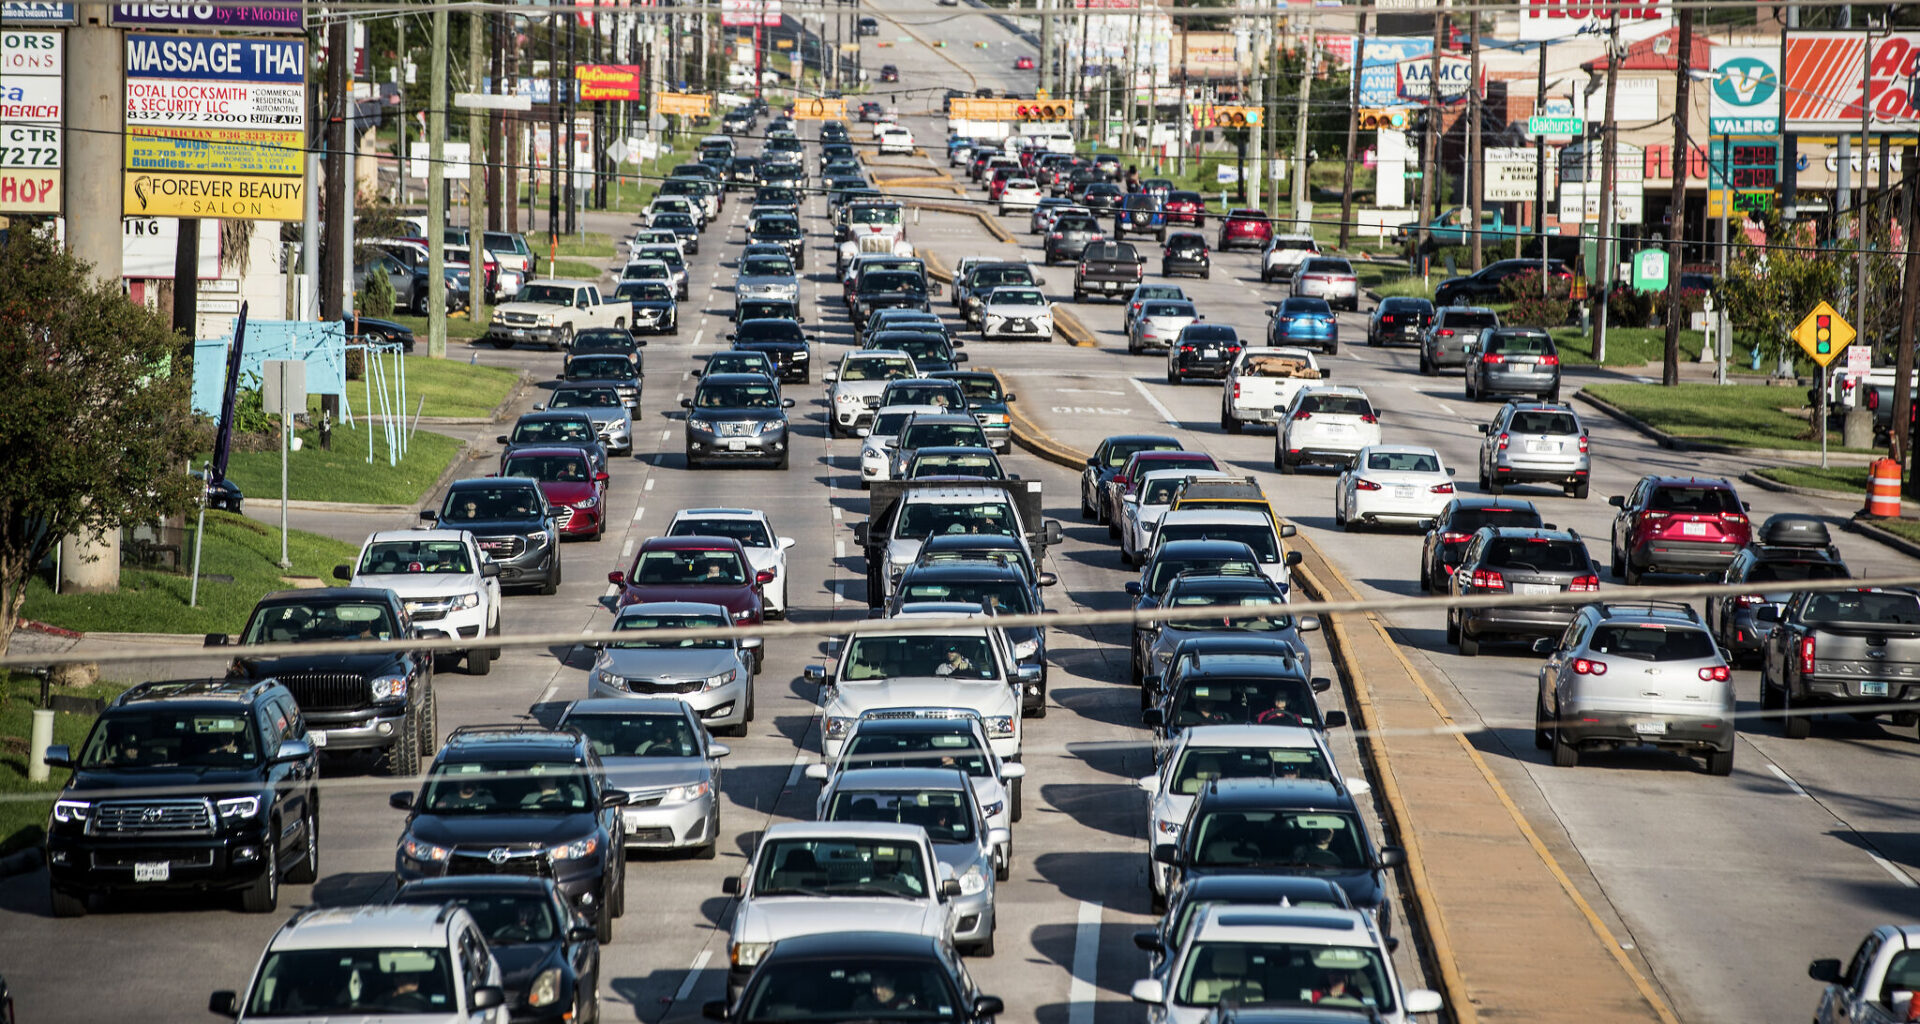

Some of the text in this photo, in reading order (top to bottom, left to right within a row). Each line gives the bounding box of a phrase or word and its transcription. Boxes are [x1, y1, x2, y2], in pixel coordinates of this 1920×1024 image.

[216, 7, 232, 23] by
[251, 6, 298, 22] Mobile
[5, 35, 55, 49] ORS
[1, 54, 54, 68] IONS
[127, 40, 303, 76] MASSAGE THAI
[128, 84, 247, 101] TOTAL LOCKSMITH
[581, 82, 630, 98] Express
[128, 98, 229, 114] & SECURITY LLC
[128, 110, 247, 123] 832 972 2000
[251, 115, 277, 124] SUITE
[132, 128, 213, 138] ELECTRICIAN
[1531, 120, 1574, 133] Oakhurst
[1714, 119, 1777, 133] VALERO
[10, 129, 56, 142] CTR
[174, 138, 208, 151] Wigs
[0, 147, 57, 165] 7272
[132, 157, 185, 168] Bundles
[2, 177, 54, 203] HOP
[152, 178, 302, 199] FOREVER BEAUTY
[193, 201, 262, 215] SALON
[1051, 406, 1132, 415] ONLY
